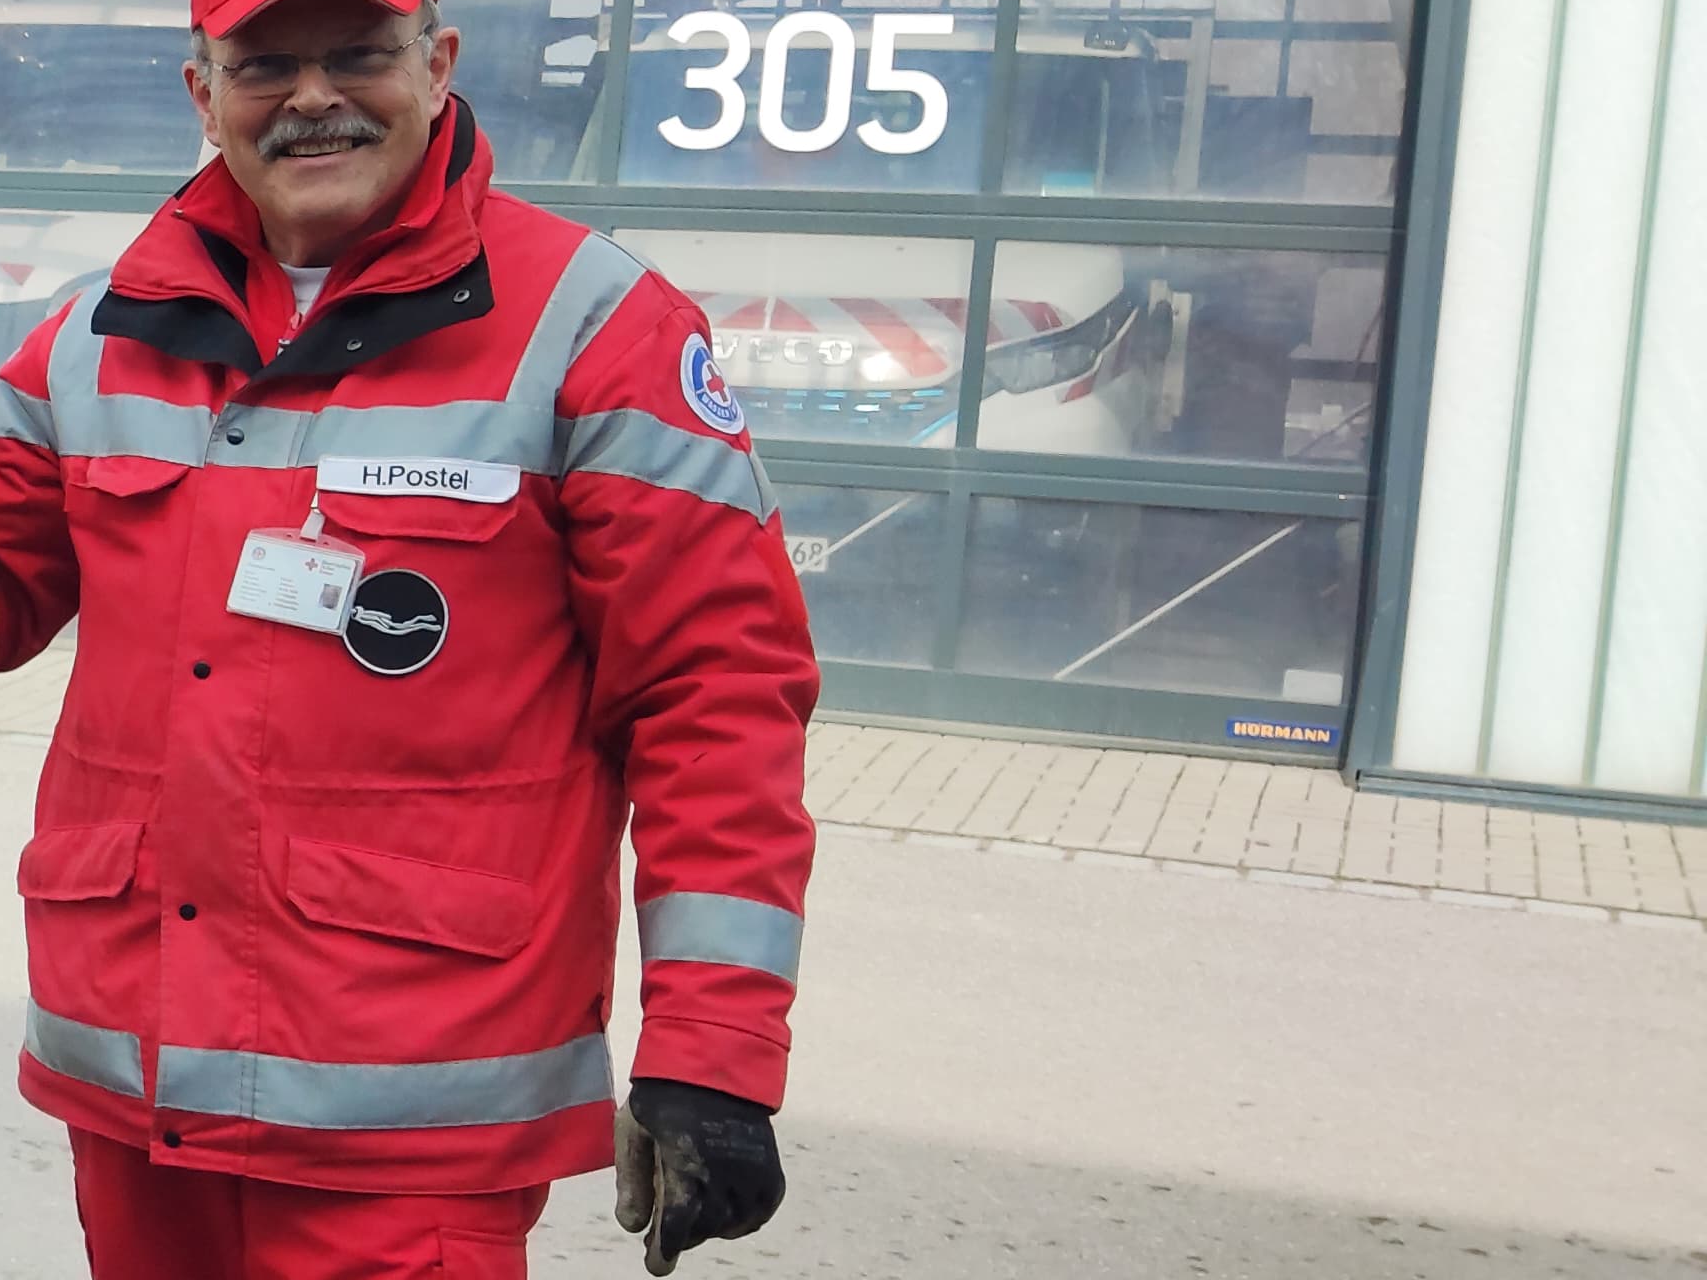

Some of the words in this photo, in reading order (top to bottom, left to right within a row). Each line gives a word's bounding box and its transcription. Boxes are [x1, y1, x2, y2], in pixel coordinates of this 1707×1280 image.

[657, 10, 954, 154] 305
[711, 334, 853, 366] VECO
[362, 465, 468, 491] H.Postel
